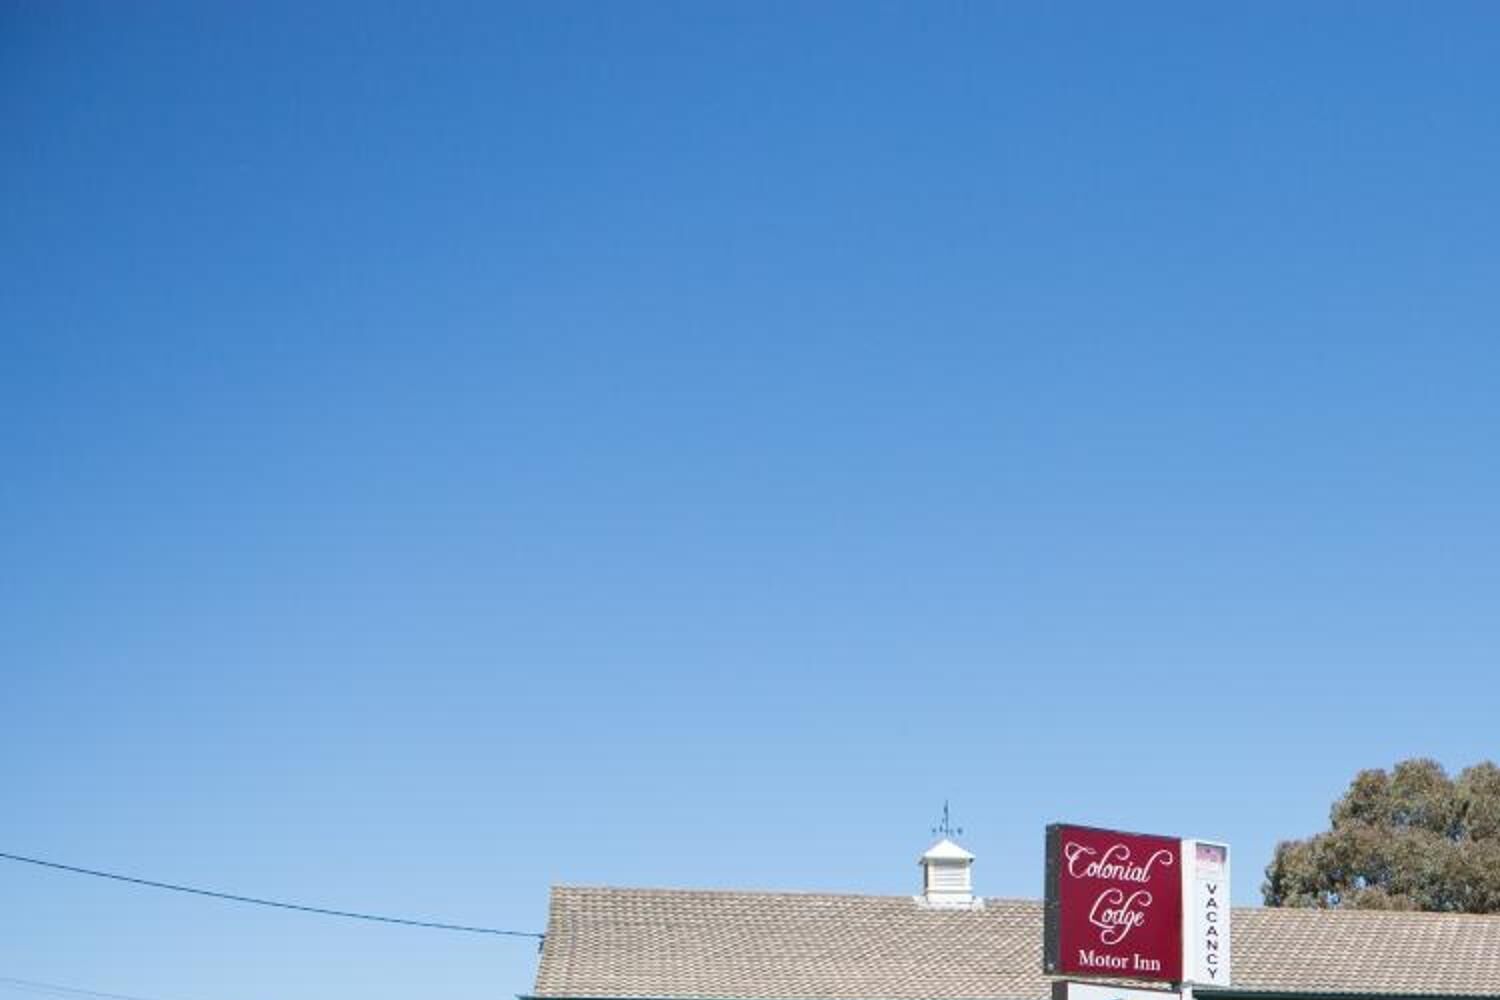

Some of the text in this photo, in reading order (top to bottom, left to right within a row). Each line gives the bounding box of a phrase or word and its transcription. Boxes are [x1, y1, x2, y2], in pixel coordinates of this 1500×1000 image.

[1065, 842, 1174, 883] Colonial
[1089, 888, 1153, 945] Lodge
[1206, 883, 1218, 979] VACANCY
[1079, 949, 1161, 971] Motor Inn
